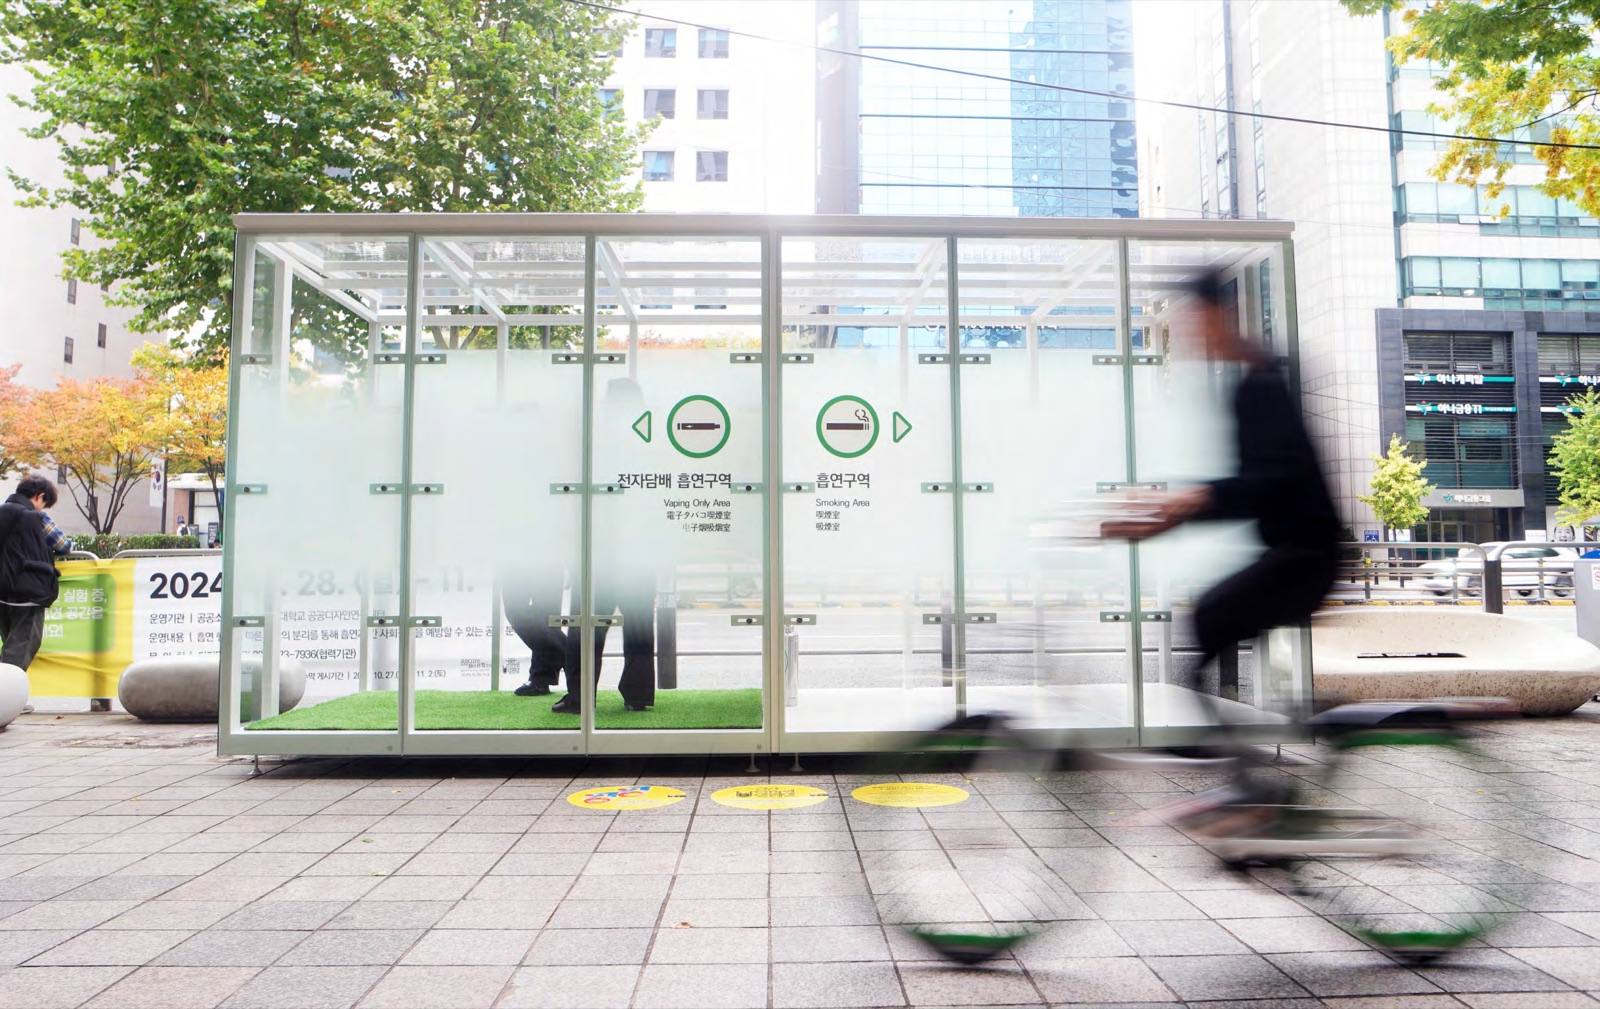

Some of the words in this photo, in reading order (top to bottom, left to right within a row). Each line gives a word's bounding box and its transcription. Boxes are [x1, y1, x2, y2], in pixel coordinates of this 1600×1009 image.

[1578, 375, 1600, 386] 하나
[617, 472, 672, 489] 전자담배
[677, 472, 732, 489] 흡연구역
[816, 472, 870, 489] 흡연구역
[664, 499, 690, 509] Vaping
[692, 498, 711, 509] Only
[713, 499, 731, 507] Area
[816, 498, 850, 508] Smoking
[853, 498, 870, 507] Area
[667, 510, 732, 520] 電子タバコ喫煙室
[149, 612, 185, 625] 운영기관
[148, 631, 185, 644] 운영내용
[293, 629, 319, 641] 분리를
[321, 628, 339, 640] 통해
